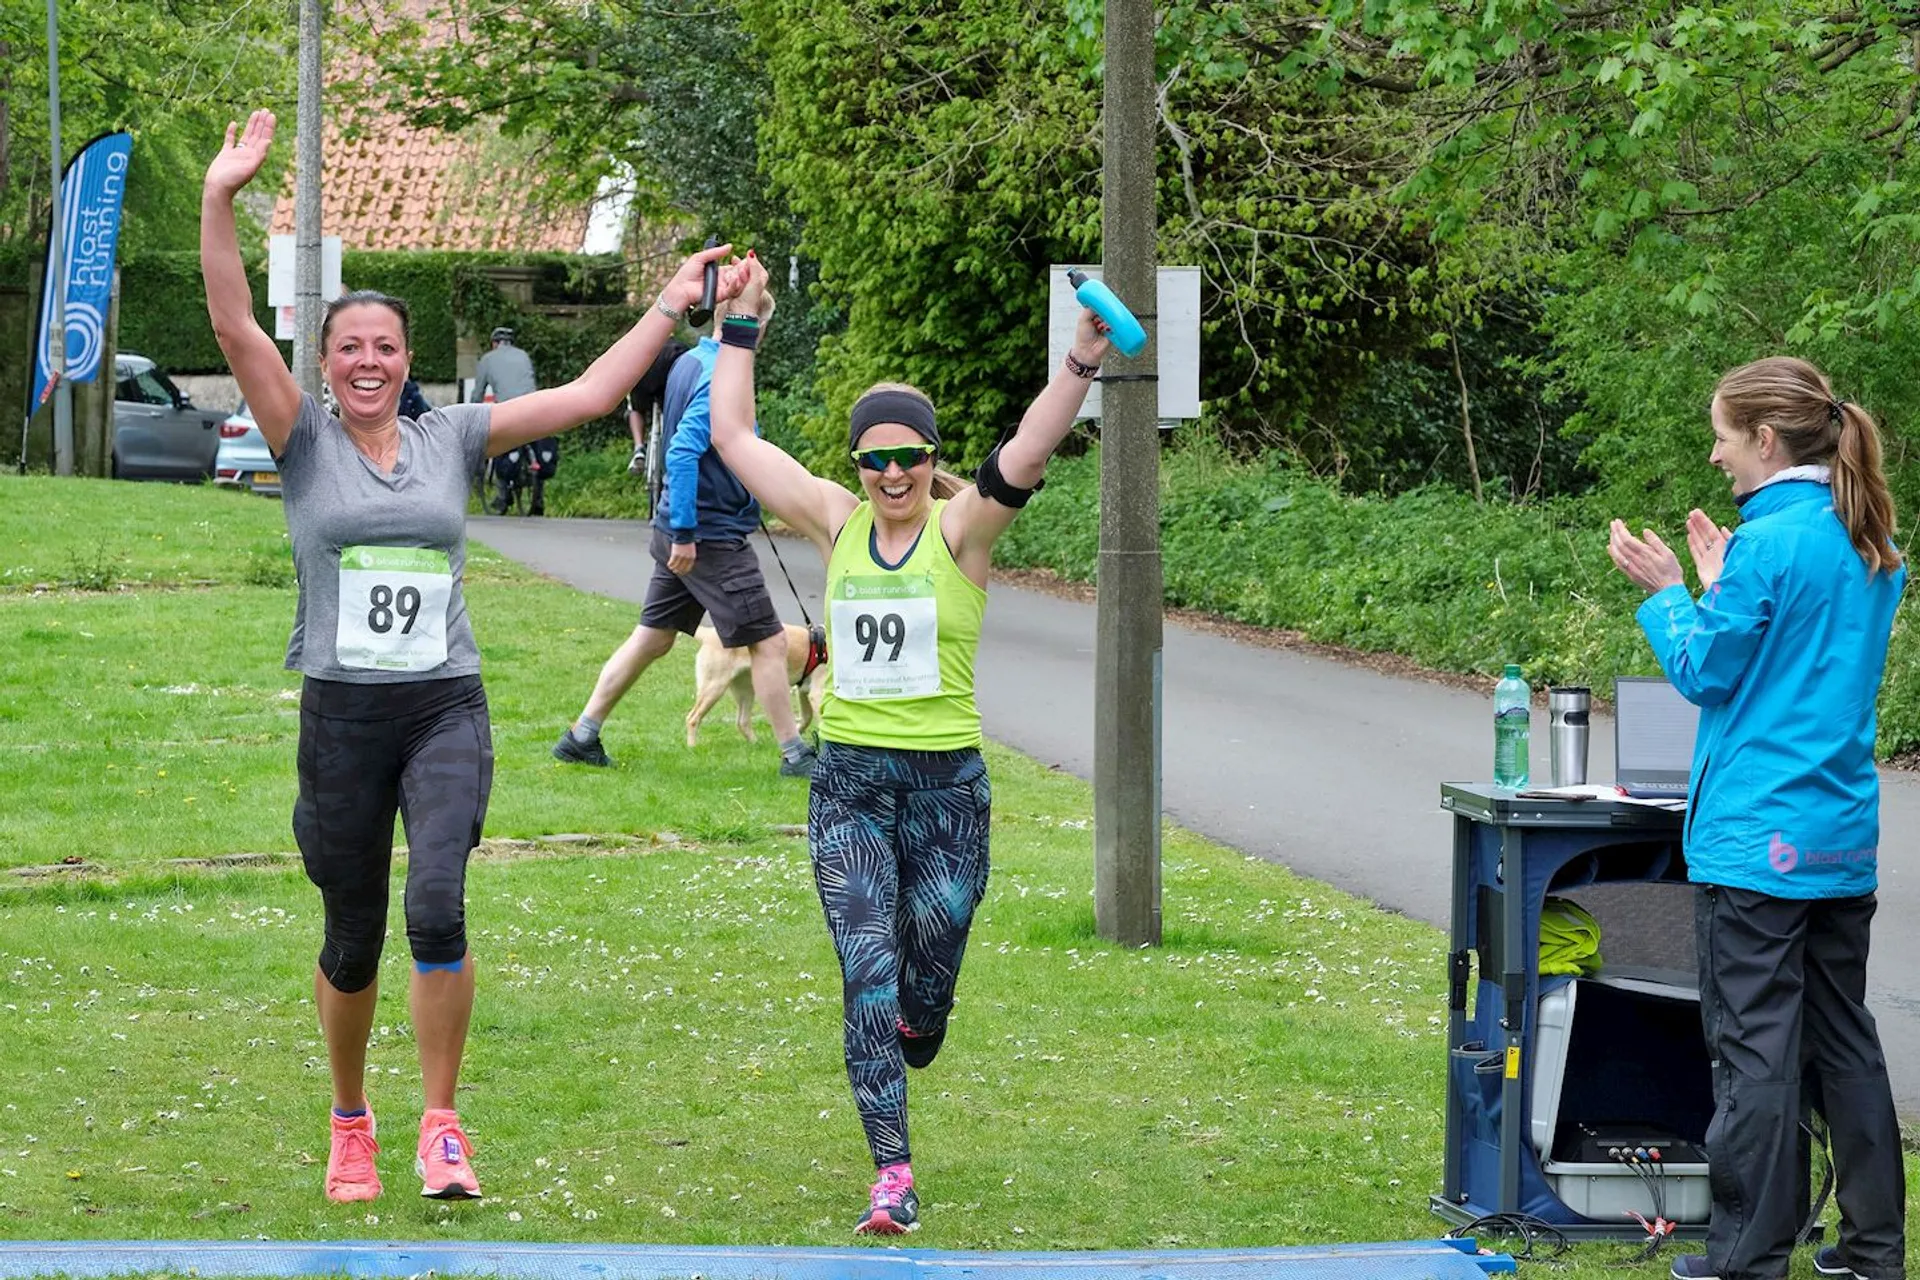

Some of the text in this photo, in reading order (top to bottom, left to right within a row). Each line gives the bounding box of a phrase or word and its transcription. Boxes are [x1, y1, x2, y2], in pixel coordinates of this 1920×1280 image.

[90, 151, 128, 287] running
[368, 584, 421, 635] 89
[855, 613, 905, 662] 99
